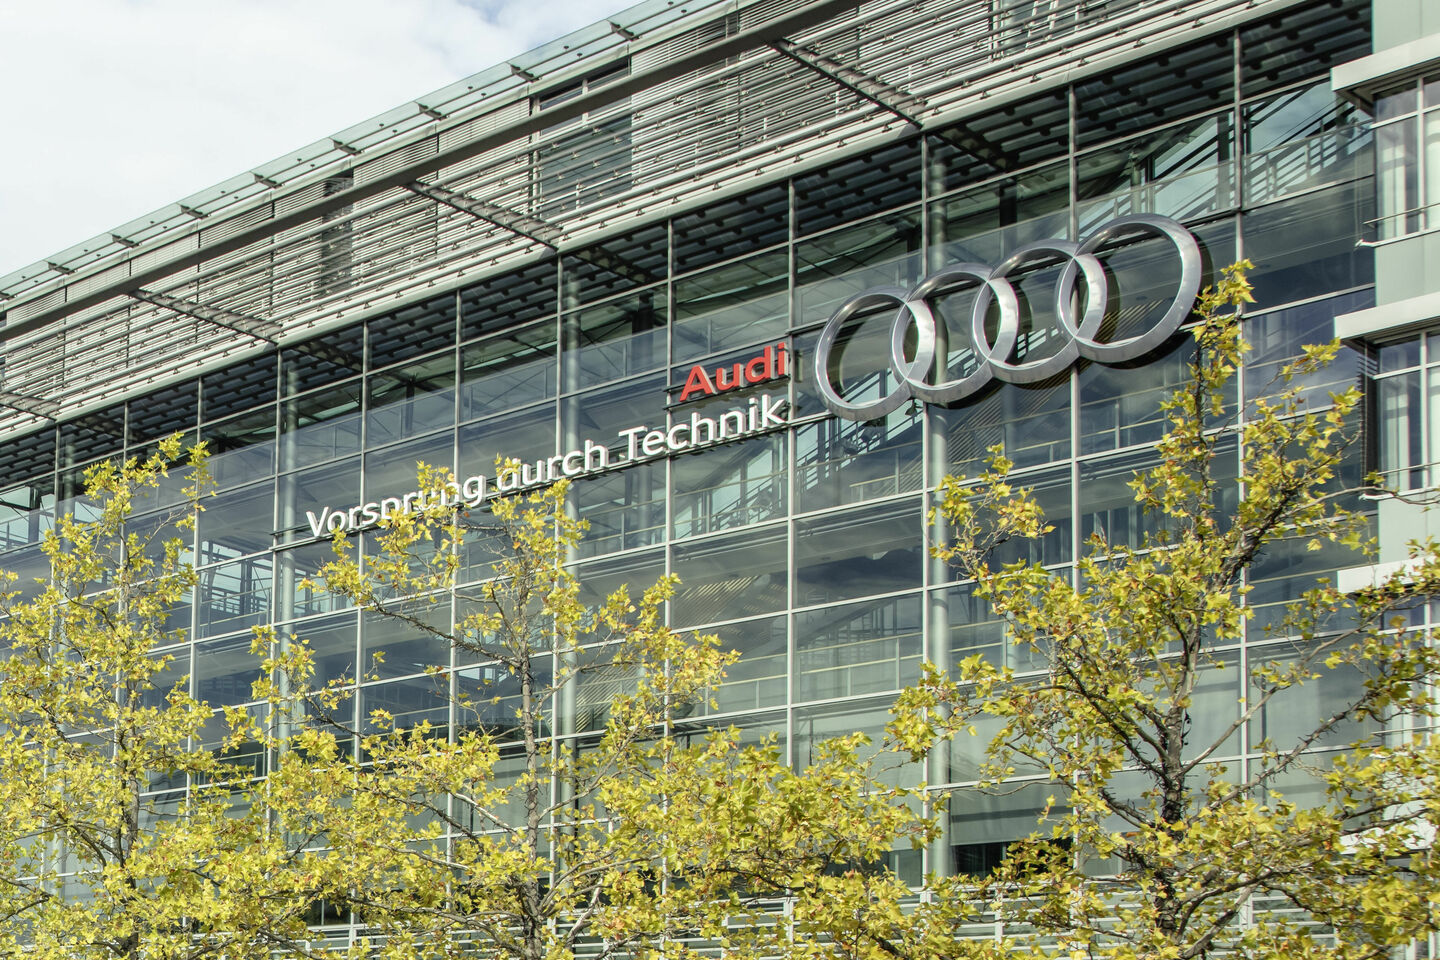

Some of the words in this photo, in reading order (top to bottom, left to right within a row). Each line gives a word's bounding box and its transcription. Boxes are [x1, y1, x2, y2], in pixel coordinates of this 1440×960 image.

[679, 342, 789, 402] Audi
[306, 474, 486, 537] Vorsprung
[497, 439, 609, 491] durch
[618, 394, 788, 461] Technik
